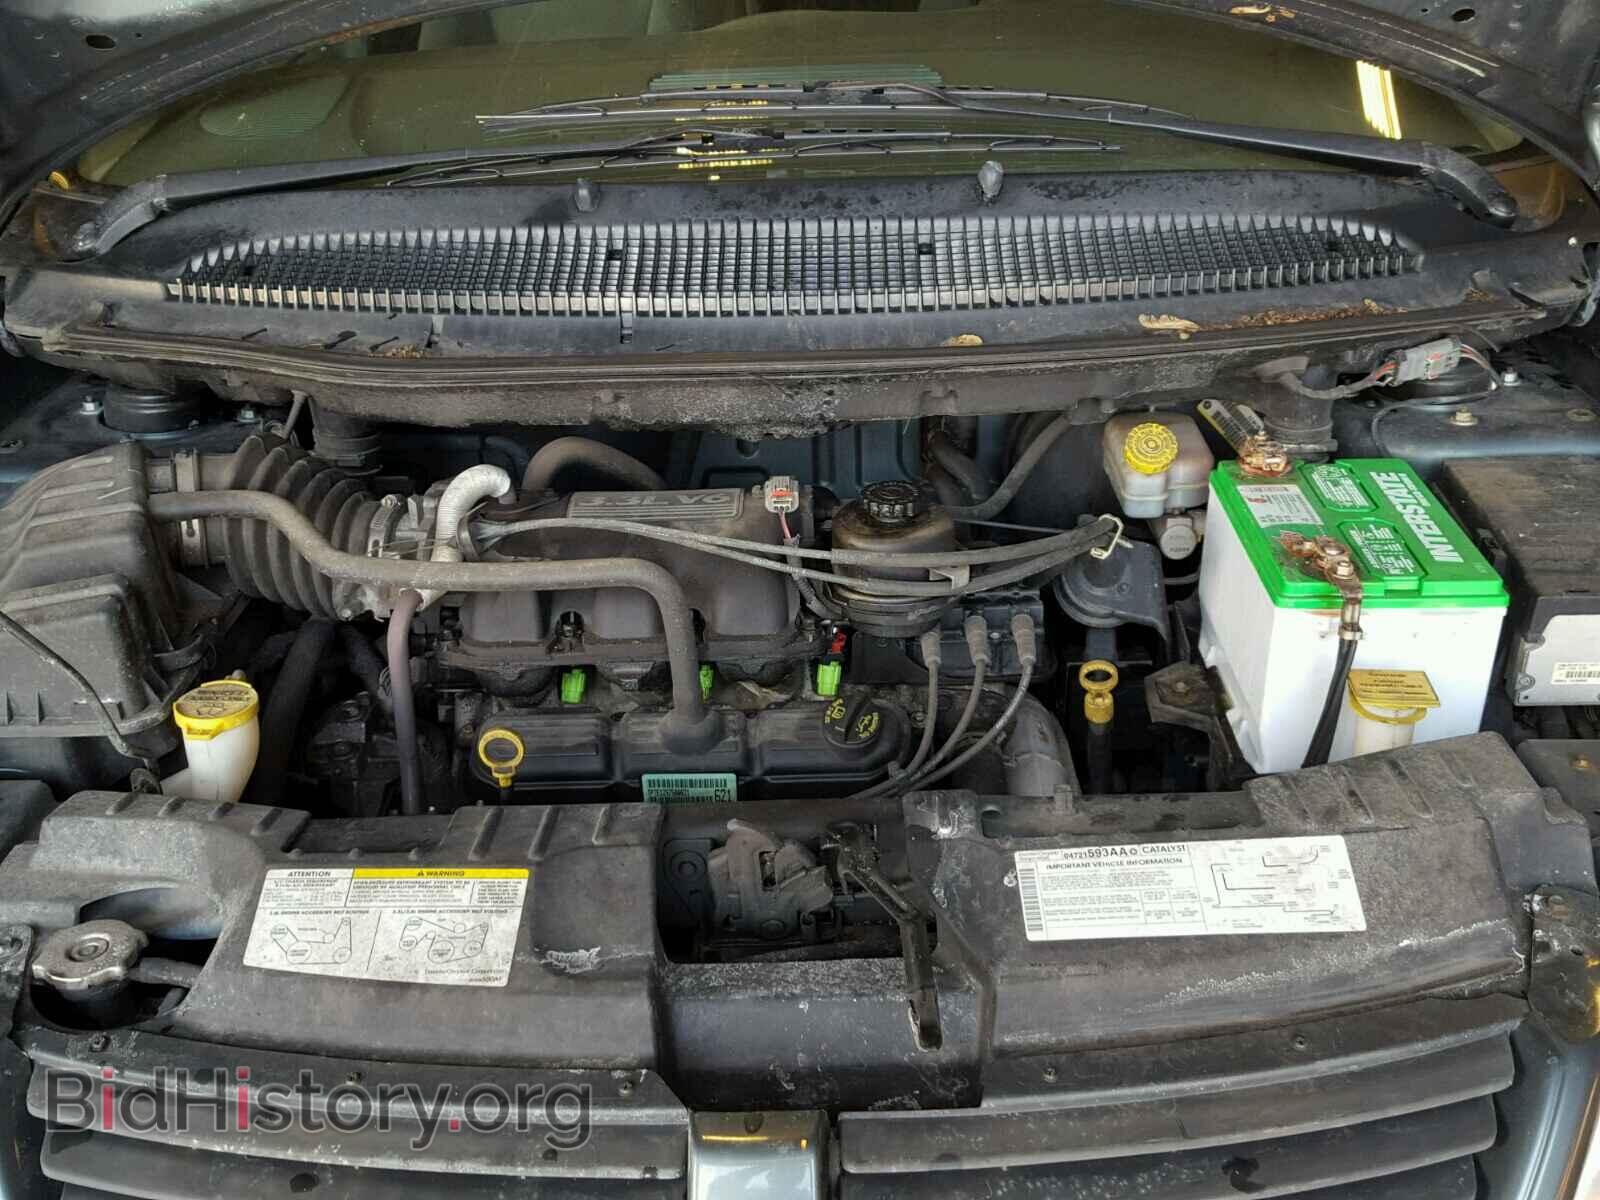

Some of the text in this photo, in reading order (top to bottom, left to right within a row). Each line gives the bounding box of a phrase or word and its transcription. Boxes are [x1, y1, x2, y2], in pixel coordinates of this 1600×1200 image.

[577, 495, 669, 506] 3.3L
[1369, 471, 1464, 563] INTERSTATE
[1142, 845, 1186, 854] CATALYST
[1046, 858, 1183, 870] IMPORTANT VEHICLE INFORMATION
